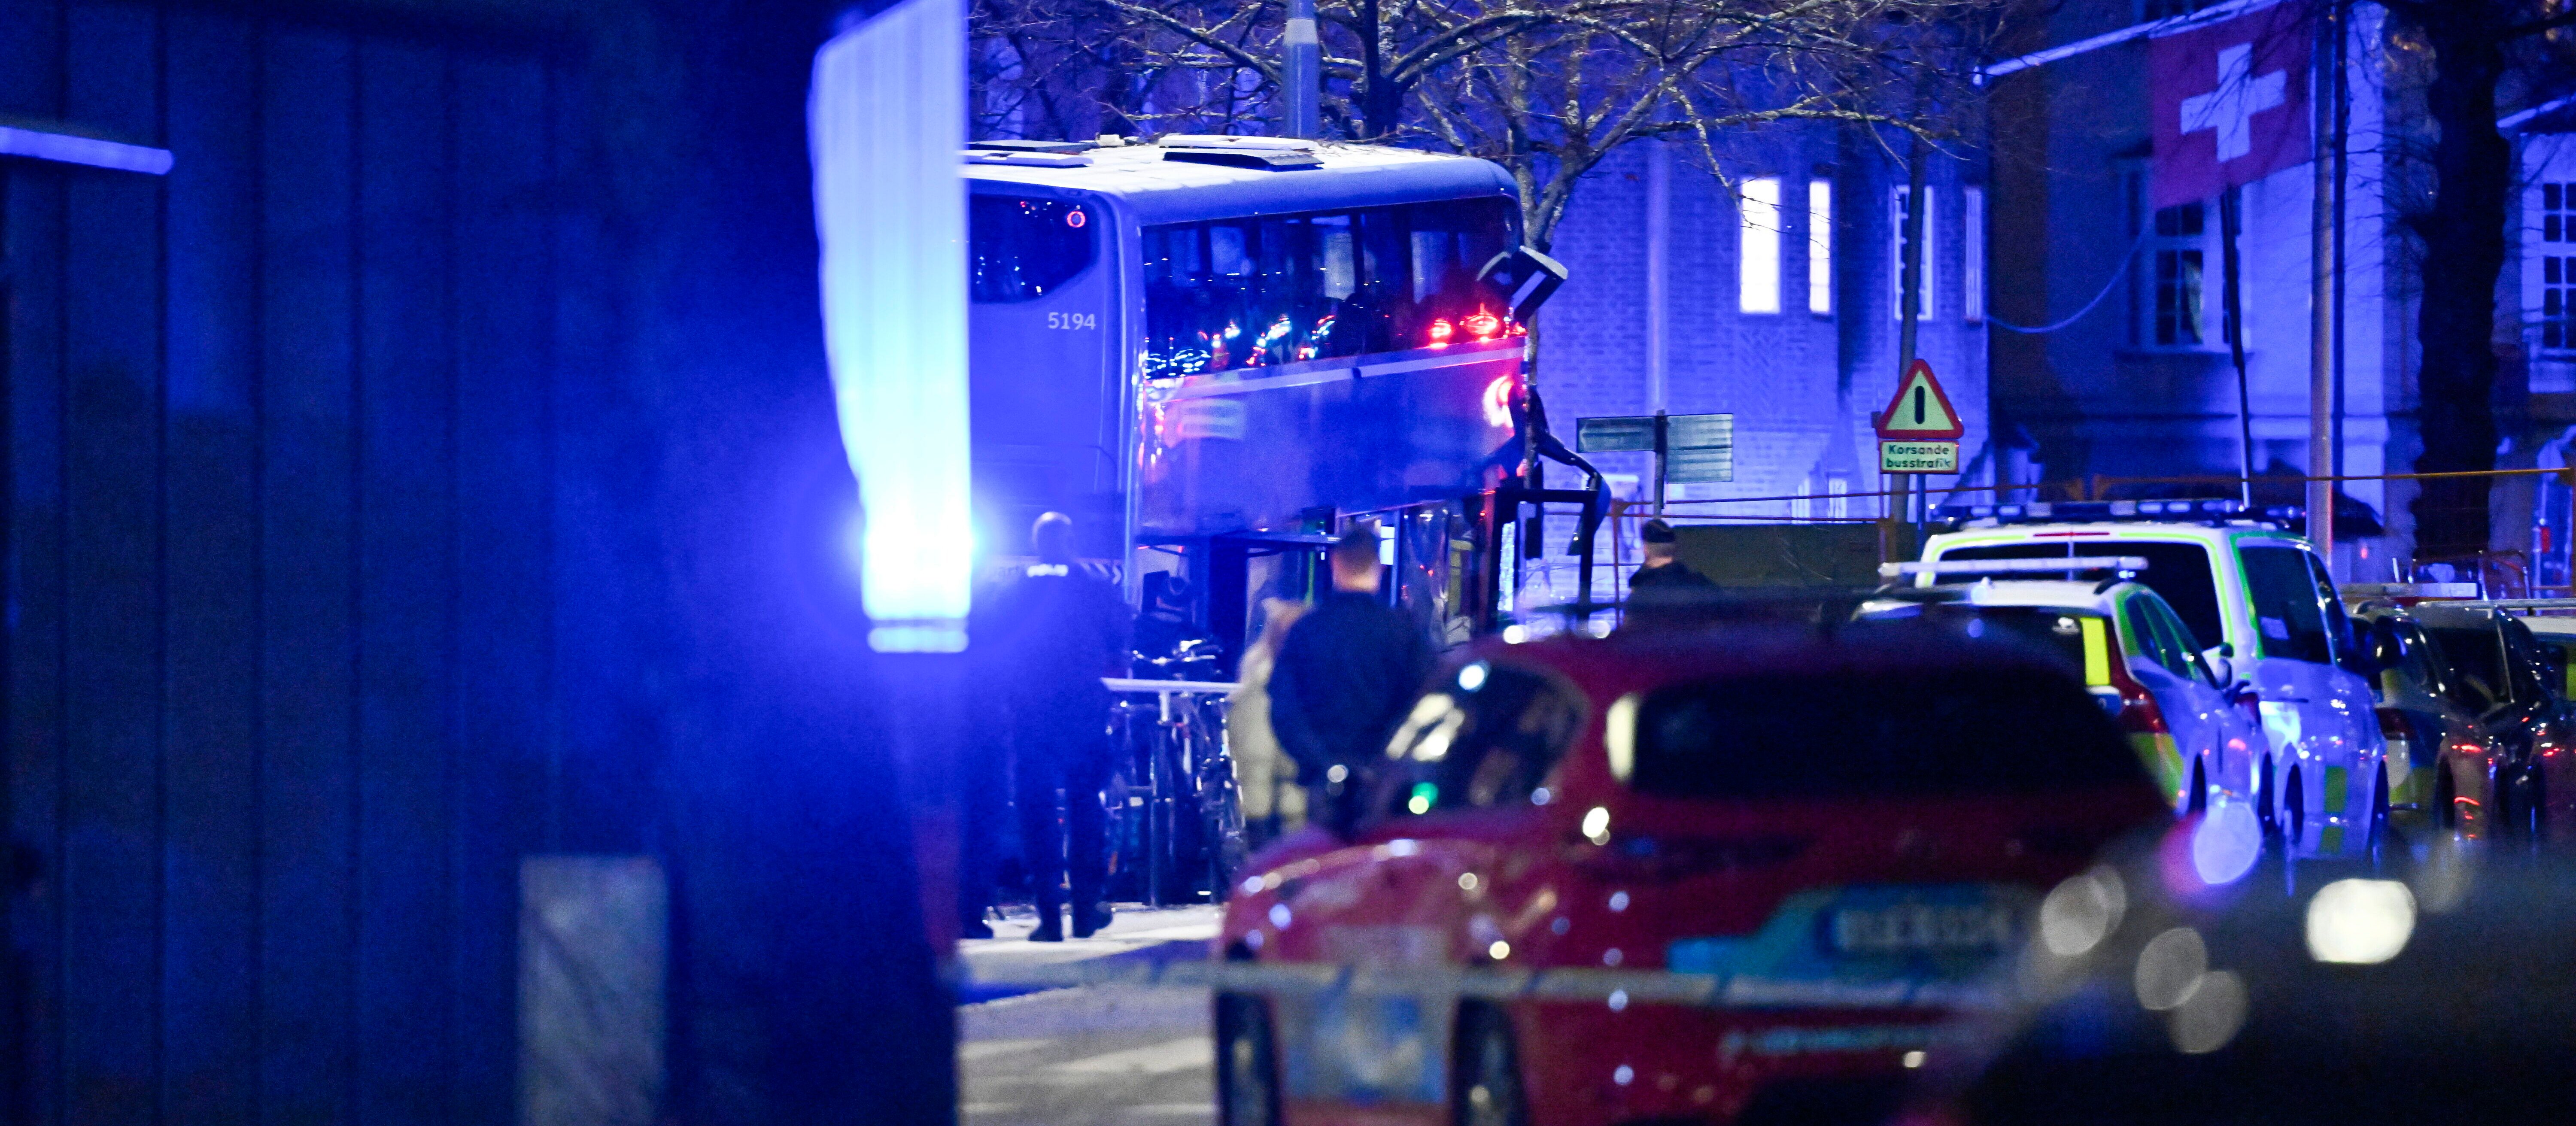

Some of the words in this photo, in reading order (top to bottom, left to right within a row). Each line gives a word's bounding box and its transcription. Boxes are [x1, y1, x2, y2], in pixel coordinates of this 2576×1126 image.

[1048, 312, 1096, 330] 5194
[1889, 445, 1949, 454] Korsande
[1886, 458, 1950, 467] busstrafik
